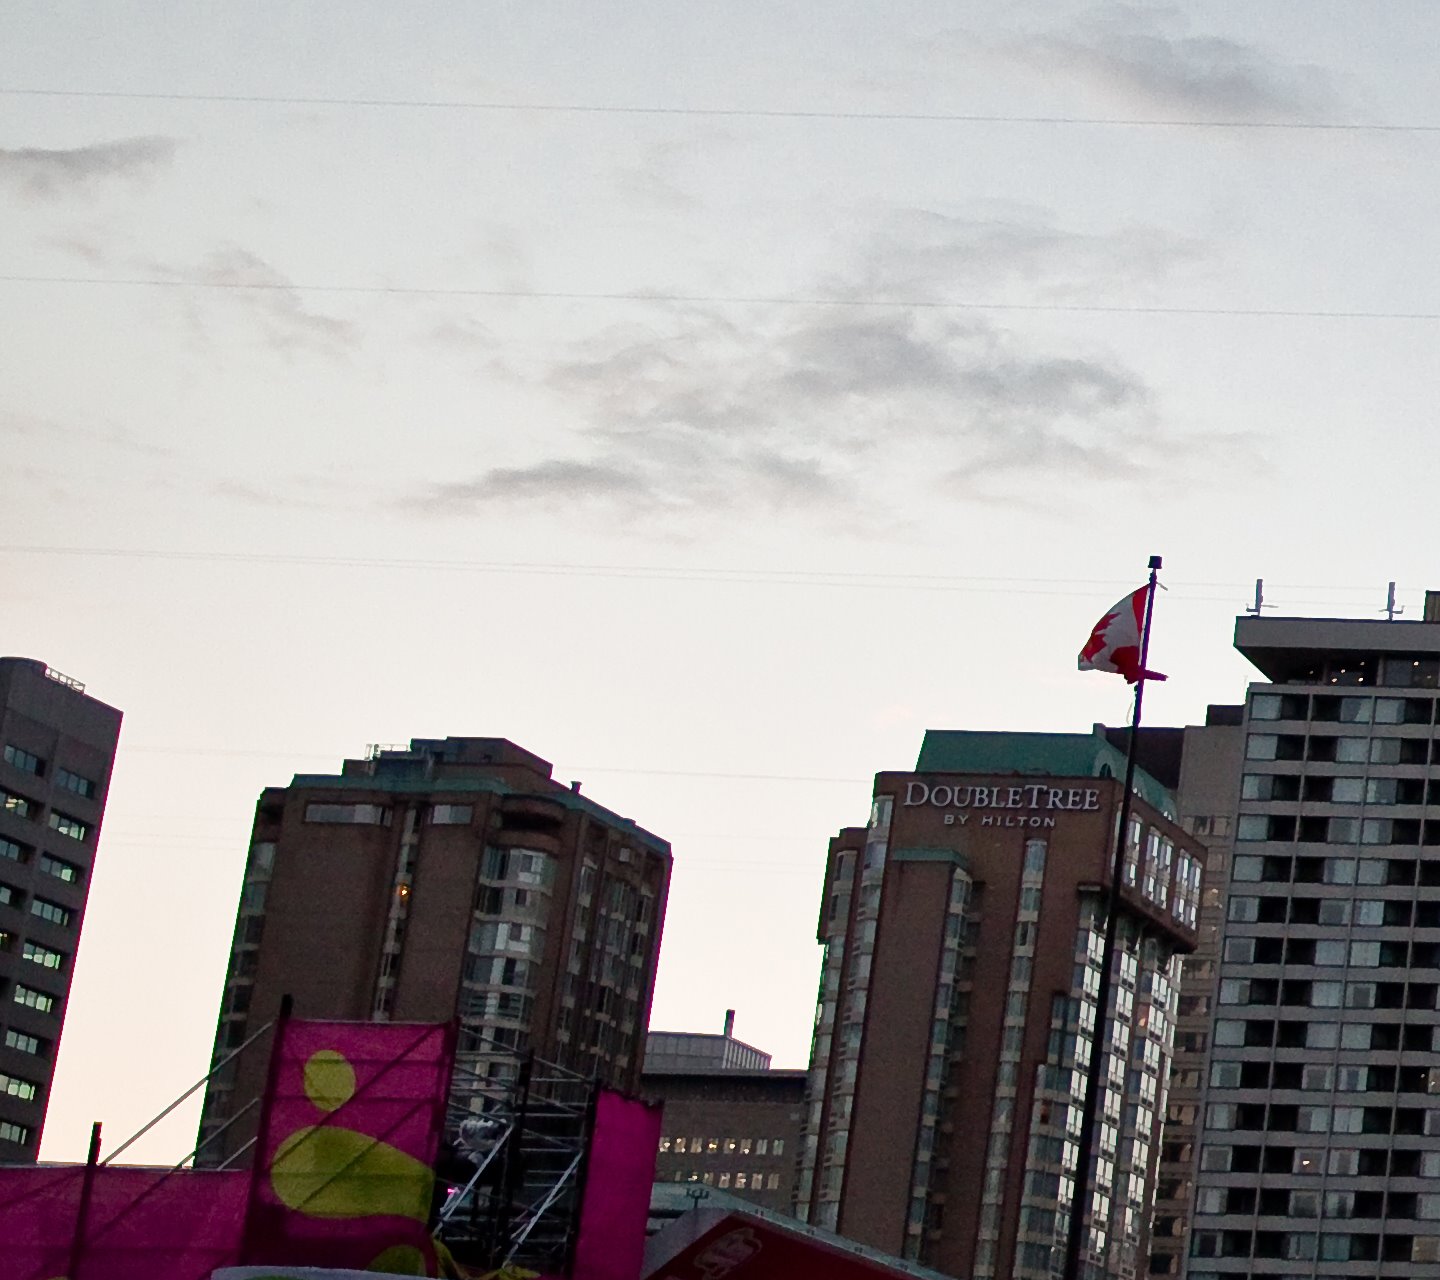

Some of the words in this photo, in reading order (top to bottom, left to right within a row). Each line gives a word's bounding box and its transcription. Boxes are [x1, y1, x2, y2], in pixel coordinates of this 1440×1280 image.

[903, 781, 1100, 810] DOUBLETREE
[943, 814, 969, 826] BY
[981, 815, 1056, 828] HILTON
